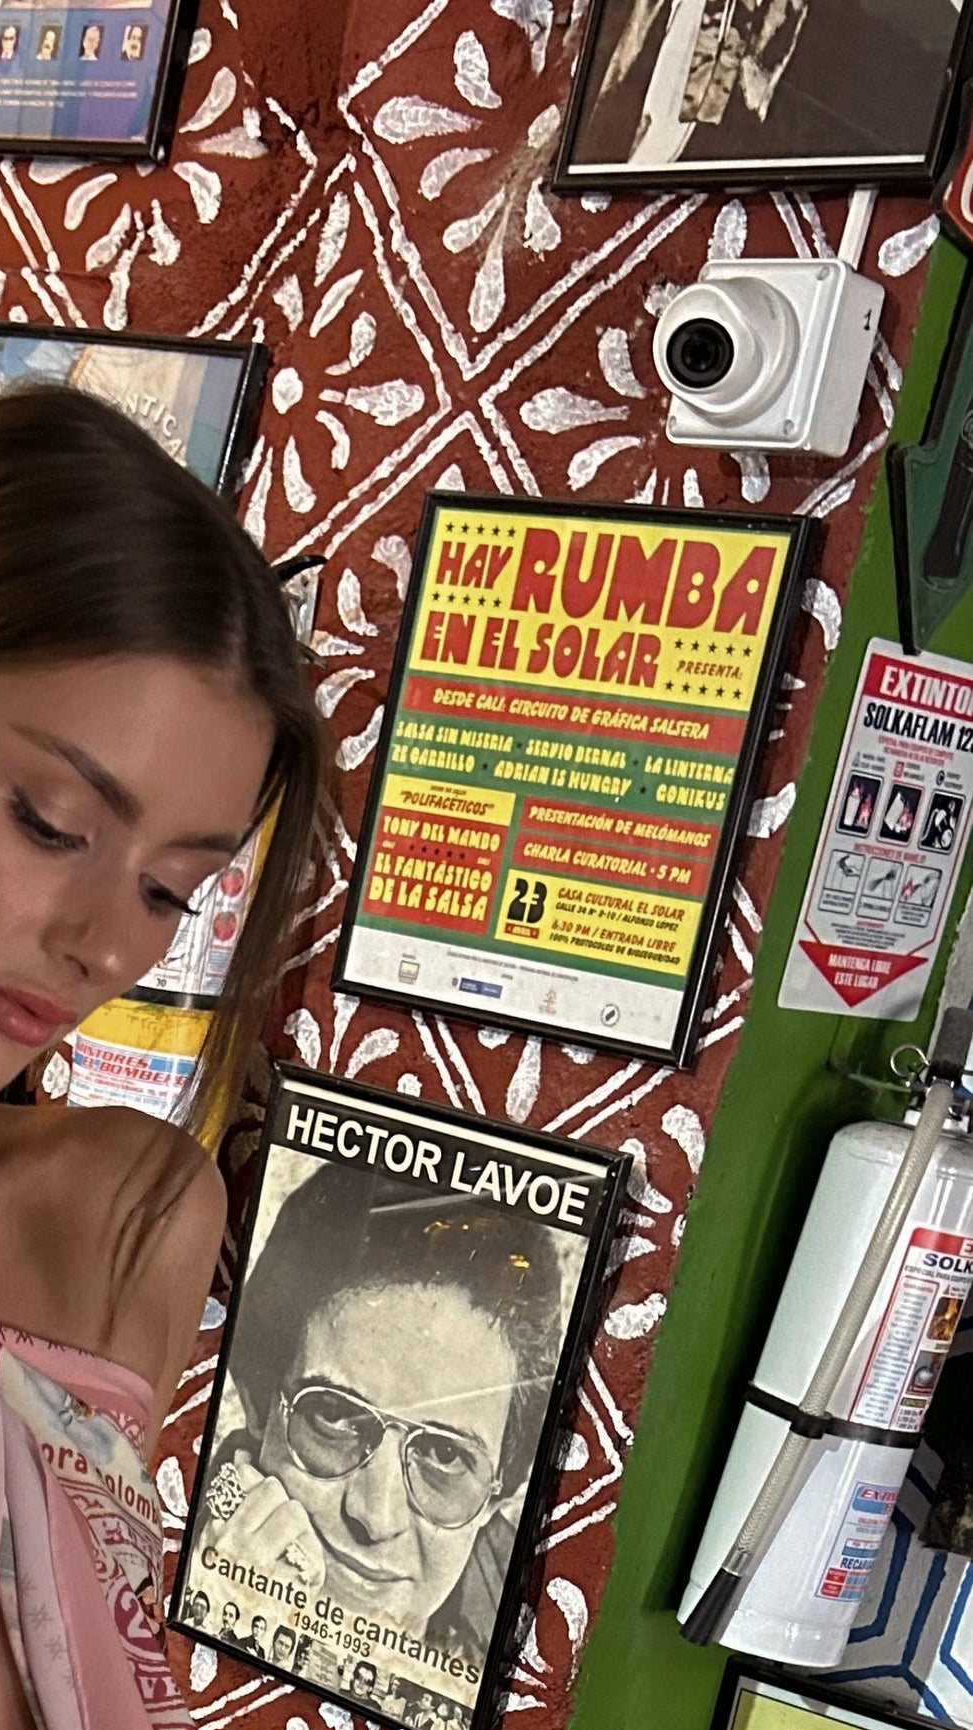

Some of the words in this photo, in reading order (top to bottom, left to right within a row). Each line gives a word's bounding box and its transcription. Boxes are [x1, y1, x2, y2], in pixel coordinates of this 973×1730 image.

[436, 541, 514, 589] HAY
[511, 528, 777, 636] RUMBA
[421, 611, 476, 665] EN
[478, 617, 520, 671] EL
[526, 623, 662, 688] SOLAR
[676, 660, 743, 680] PRESENTA:
[433, 688, 475, 709] DESDE
[509, 699, 568, 720] CIRCUITO
[570, 707, 591, 723] DE
[591, 707, 648, 732] GRÁFICA
[649, 717, 710, 740] SALSERA
[880, 664, 973, 719] EXTINTO
[863, 702, 955, 749] SOLKAFLAM
[395, 721, 435, 741] SALSA
[436, 726, 459, 745] SIN
[460, 730, 513, 752] MISERIA
[525, 738, 573, 762] SERVIO
[575, 745, 627, 769] BERNAL
[644, 755, 663, 774] LA
[664, 759, 736, 785] LINTERNA
[410, 747, 475, 773] CARRILLO
[493, 760, 551, 784] ADRIAN
[551, 768, 566, 787] IS
[568, 771, 632, 797] HUNGRY
[383, 815, 420, 837] TONY
[420, 822, 445, 842] DEL
[447, 826, 501, 852] MAMBO
[529, 805, 614, 834] PRESENTACIÓN
[615, 820, 633, 835] DE
[633, 822, 712, 848] MELÓMANOS
[374, 852, 391, 875] EL
[393, 855, 493, 892] FANTÁSTICO
[523, 841, 570, 864] CHARLA
[572, 850, 647, 877] CURATORIAL
[656, 865, 667, 880] 5
[669, 867, 692, 885] PM
[368, 876, 395, 903] DE
[397, 881, 423, 909] LA
[424, 886, 489, 922] SALSA
[506, 877, 548, 924] 23
[557, 887, 583, 900] CASA
[584, 891, 634, 911] CULTURAL
[636, 901, 650, 914] EL
[650, 904, 686, 922] SOLAR
[575, 923, 591, 936] PM
[599, 928, 645, 948] ENTRADA
[646, 937, 677, 953] LIBRE
[285, 1103, 440, 1184] HECTOR
[451, 1146, 590, 1226] LAVOE
[200, 1546, 308, 1611] Cantante
[313, 1596, 346, 1628] de
[352, 1612, 481, 1685] cantantes
[292, 1610, 372, 1660] 1946-1993
